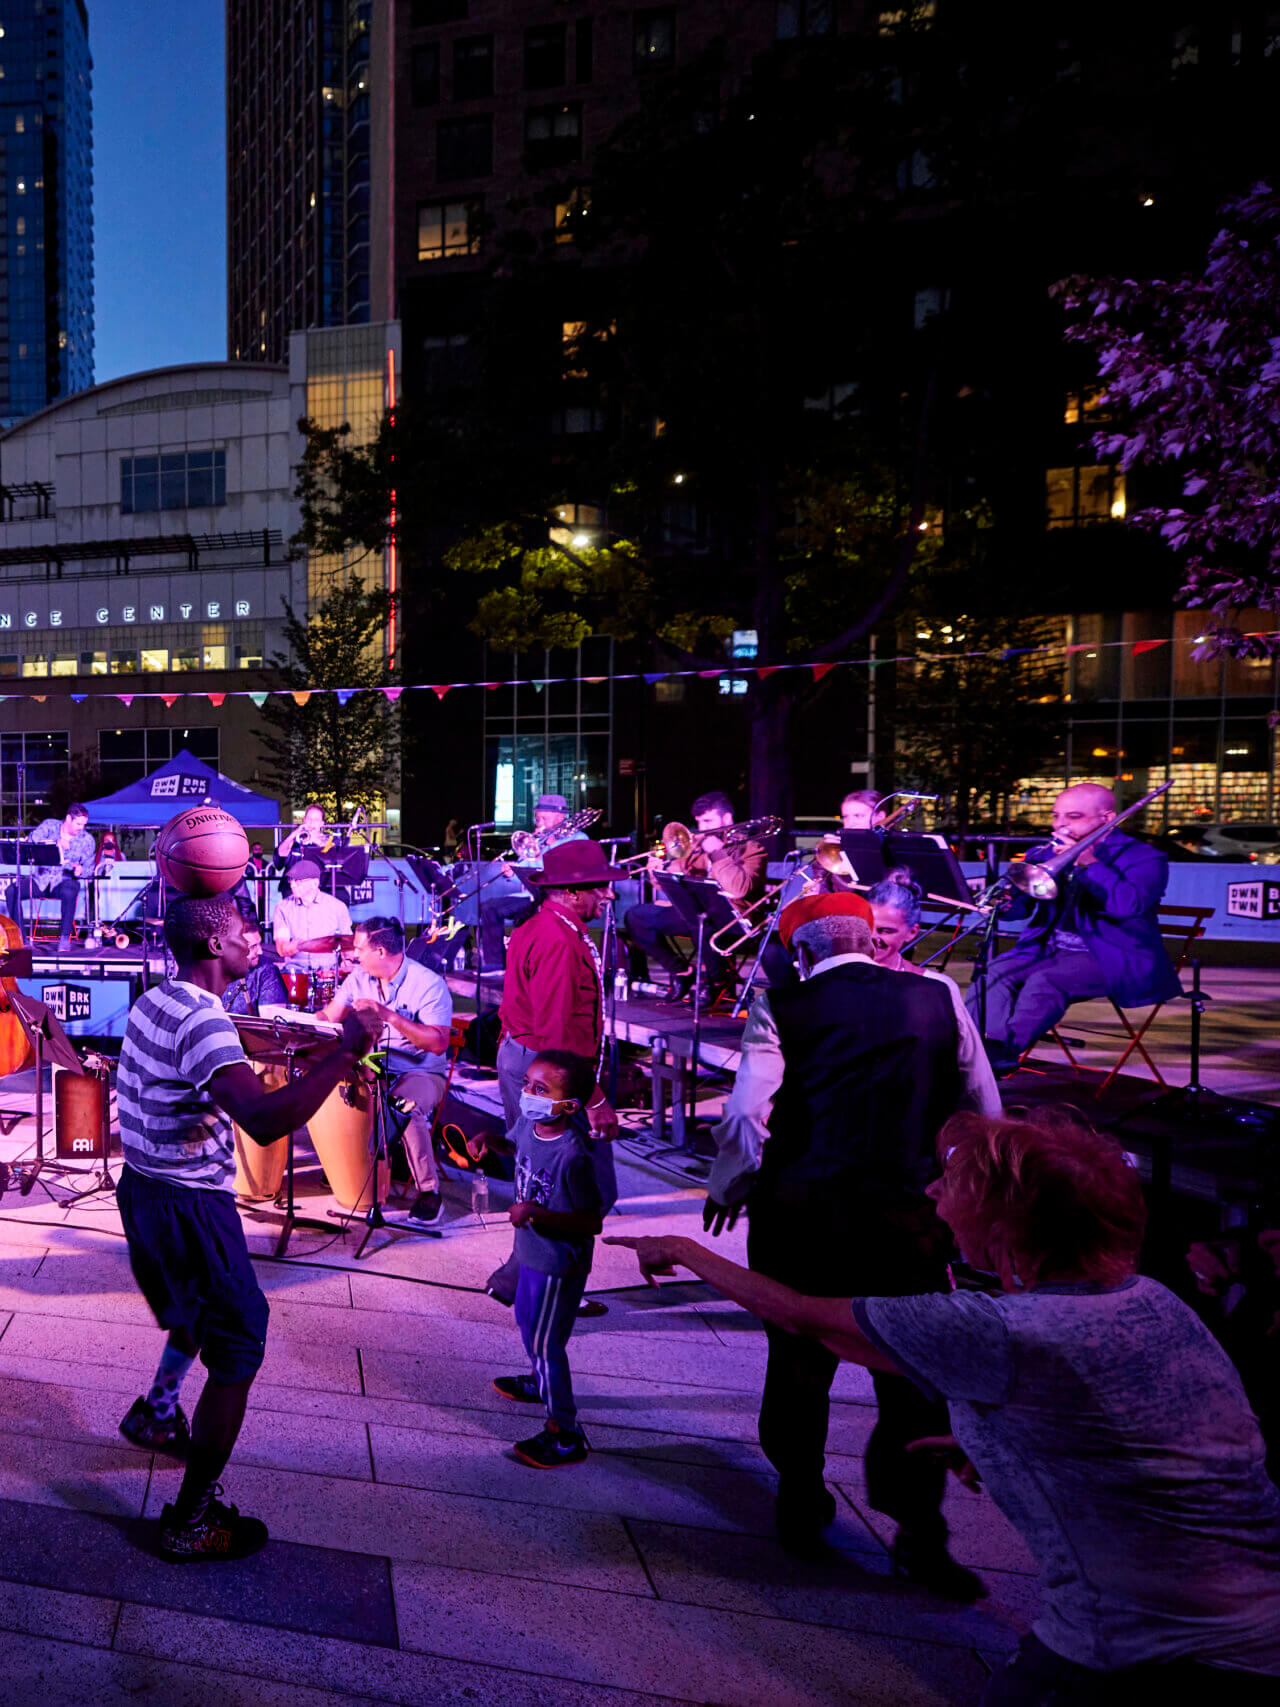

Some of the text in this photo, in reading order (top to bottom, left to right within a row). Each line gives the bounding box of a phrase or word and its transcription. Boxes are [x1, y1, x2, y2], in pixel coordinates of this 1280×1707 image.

[96, 601, 251, 624] CENTER
[183, 777, 207, 787] BRK
[182, 786, 207, 795] LYN
[354, 890, 373, 900] LYN
[1231, 887, 1258, 898] DWN
[1230, 900, 1258, 912] TWN
[45, 990, 90, 1004] DWN BRK
[69, 1003, 91, 1018] LYN
